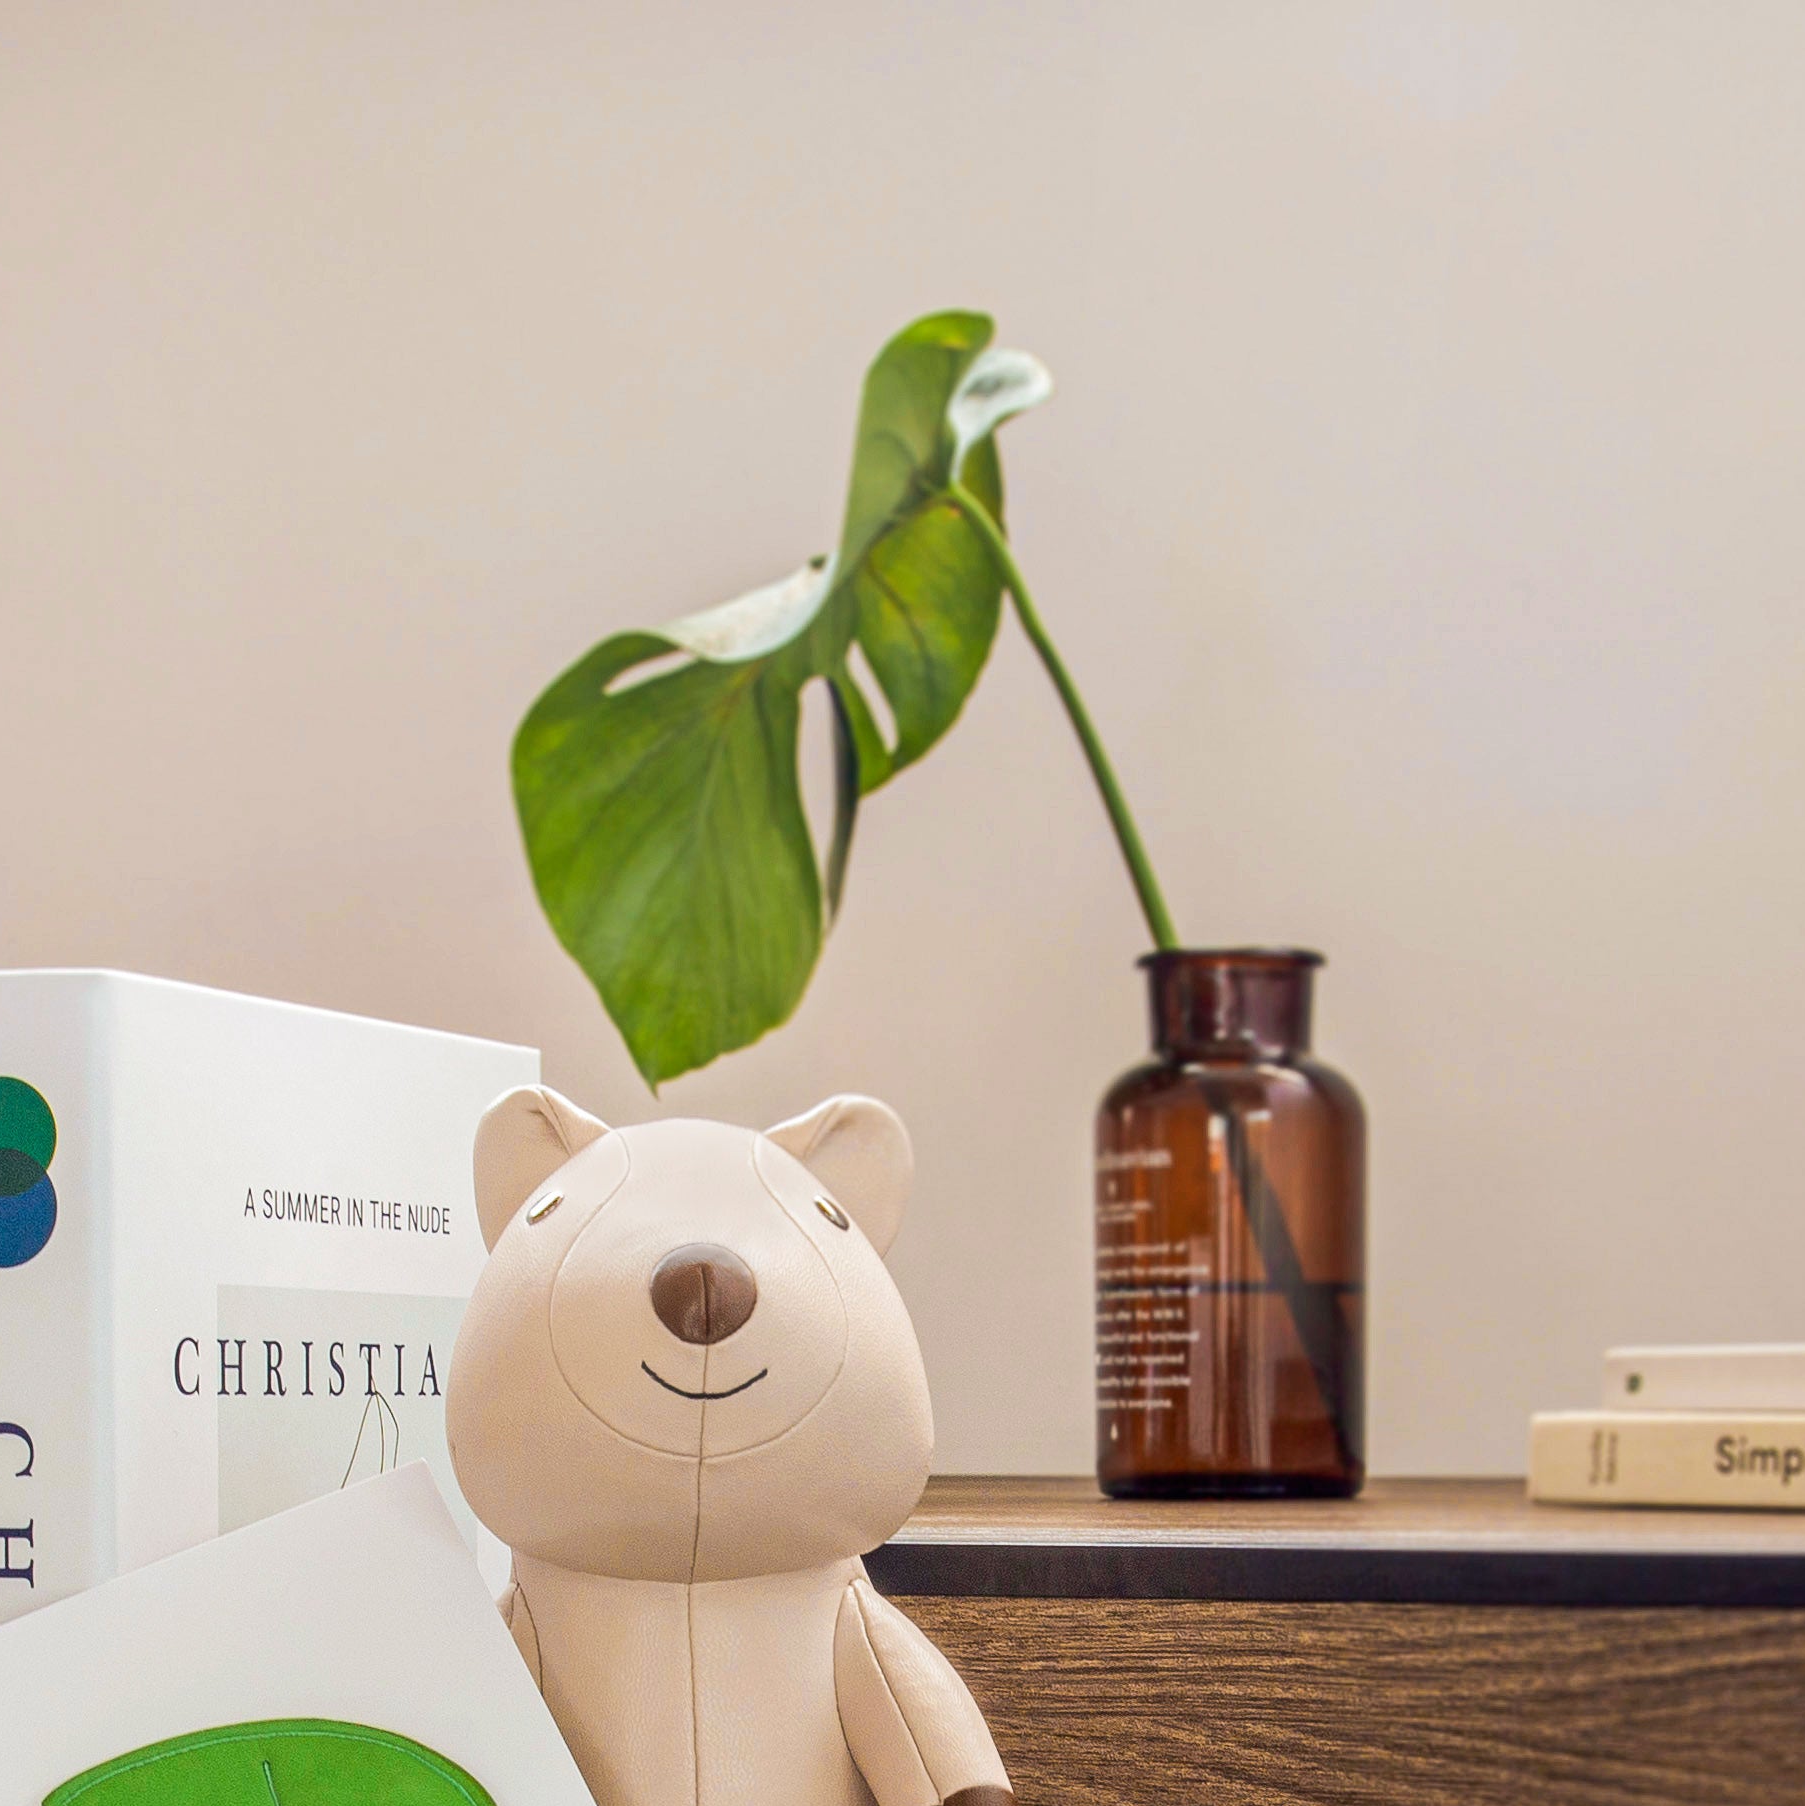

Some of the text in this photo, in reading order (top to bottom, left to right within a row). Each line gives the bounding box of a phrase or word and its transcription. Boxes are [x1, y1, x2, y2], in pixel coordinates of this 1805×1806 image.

[243, 1186, 451, 1237] A SUMMER IN THE NUDE
[174, 1336, 442, 1397] CHRISTIA
